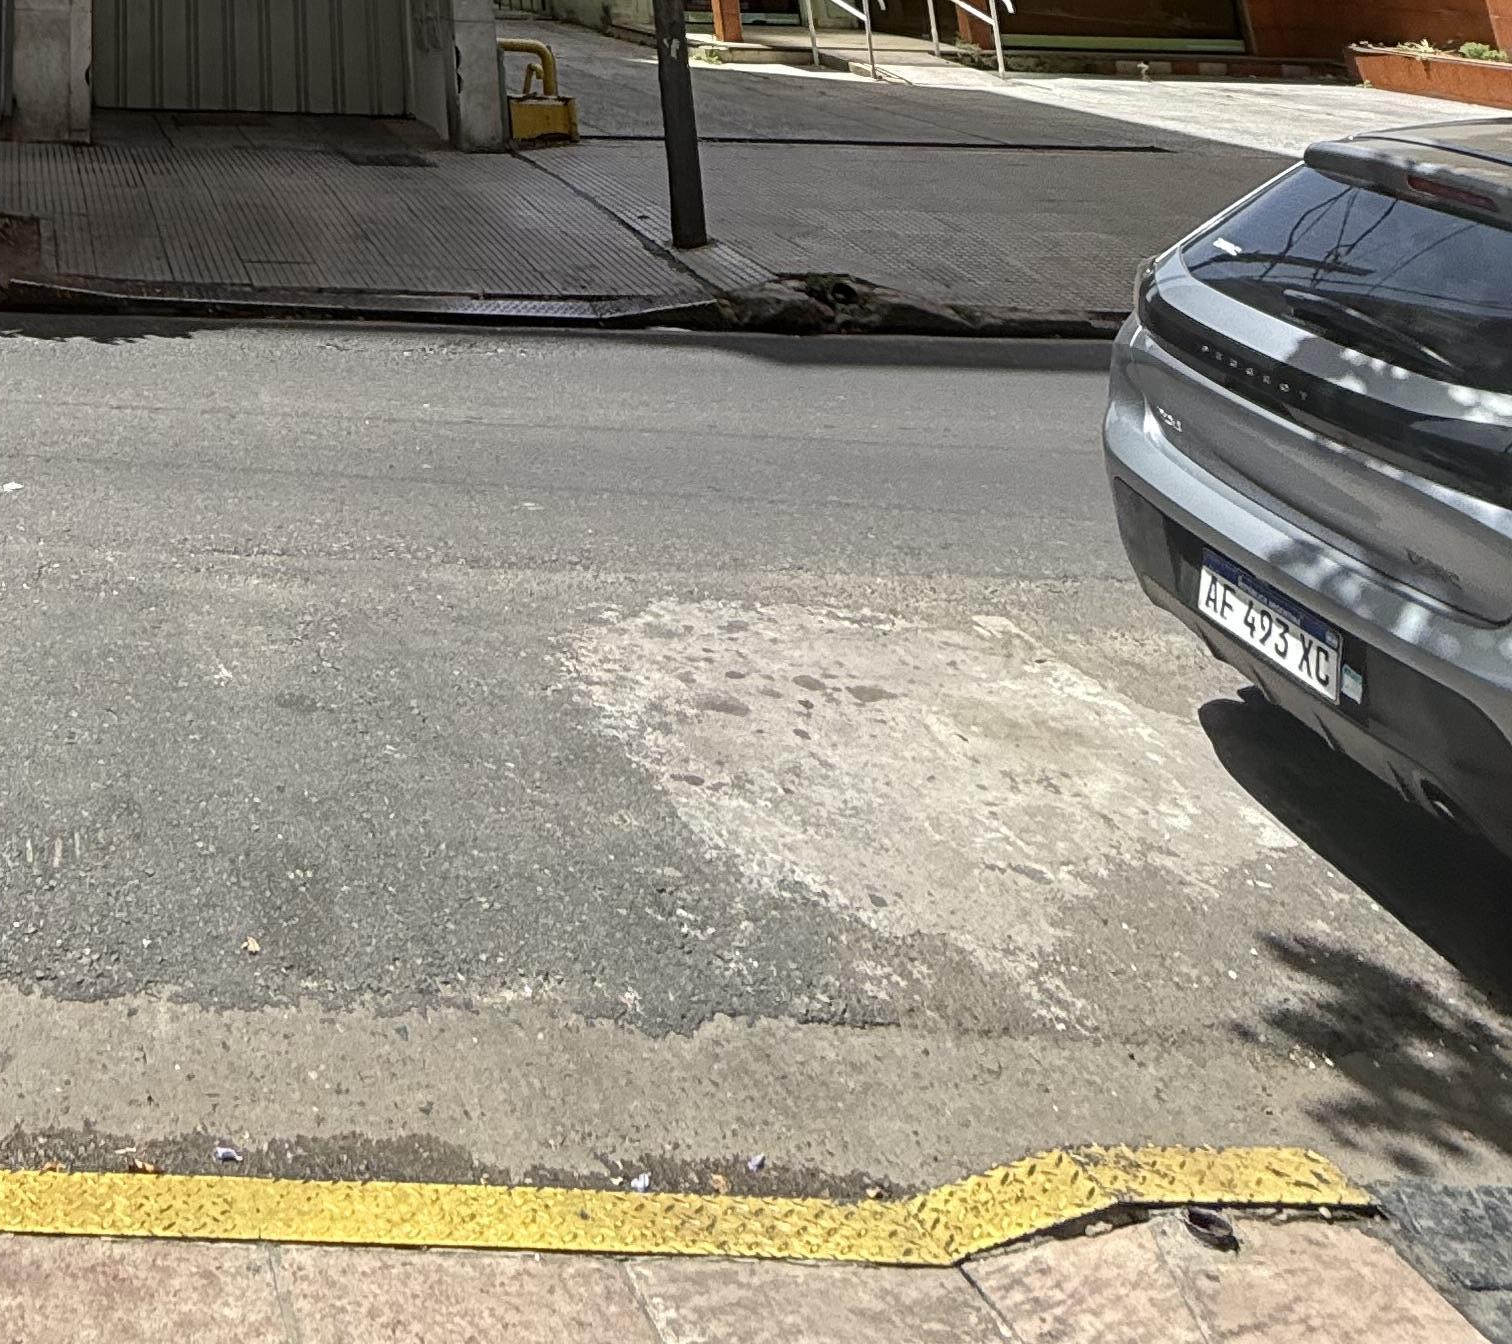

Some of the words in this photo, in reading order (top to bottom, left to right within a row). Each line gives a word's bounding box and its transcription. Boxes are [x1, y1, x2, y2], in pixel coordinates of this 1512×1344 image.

[1205, 574, 1236, 621] AF
[1243, 599, 1290, 661] 493
[1299, 632, 1330, 688] XC
